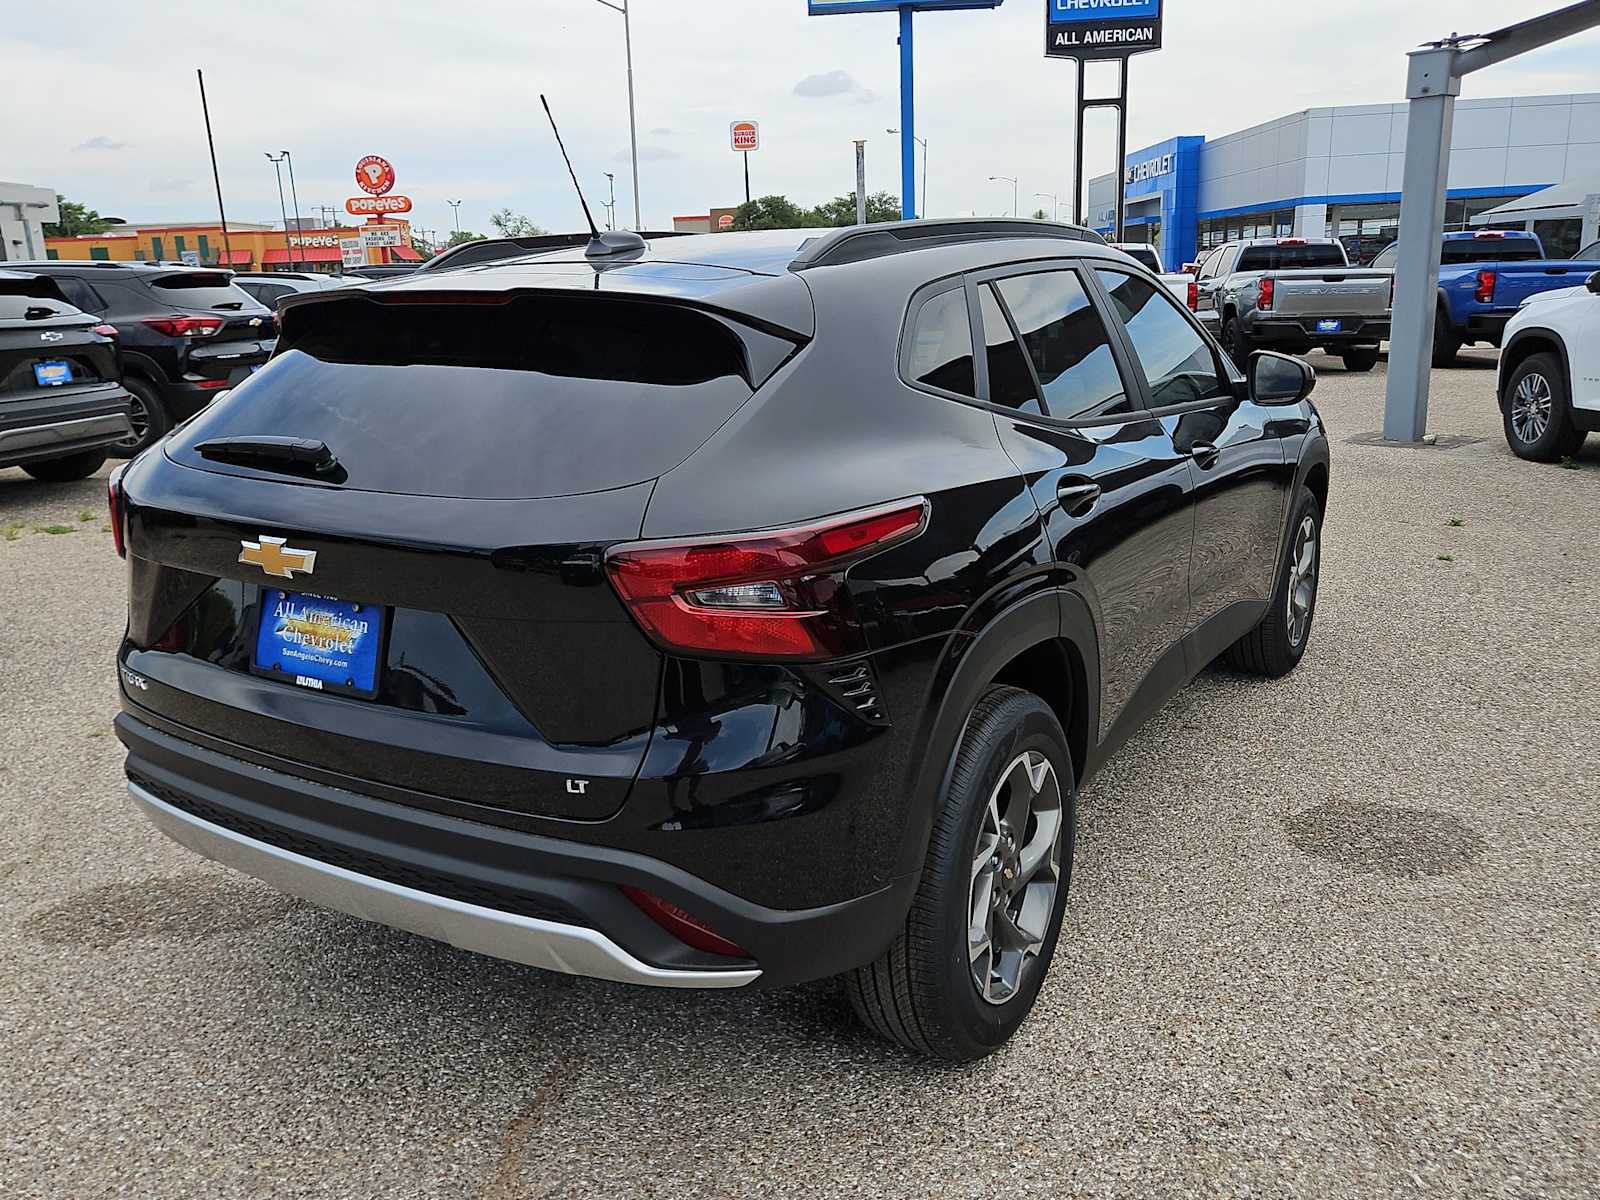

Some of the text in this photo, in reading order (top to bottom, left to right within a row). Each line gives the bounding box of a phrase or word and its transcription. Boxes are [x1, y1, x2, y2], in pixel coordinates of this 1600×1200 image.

[1055, 27, 1153, 46] ALL AMERICAN
[734, 136, 756, 144] KING
[1133, 153, 1173, 181] CHEVROLET
[273, 601, 369, 634] All American
[282, 625, 355, 655] Chevrolet
[282, 648, 348, 668] SanAngeloChevy.com
[566, 779, 590, 794] LT
